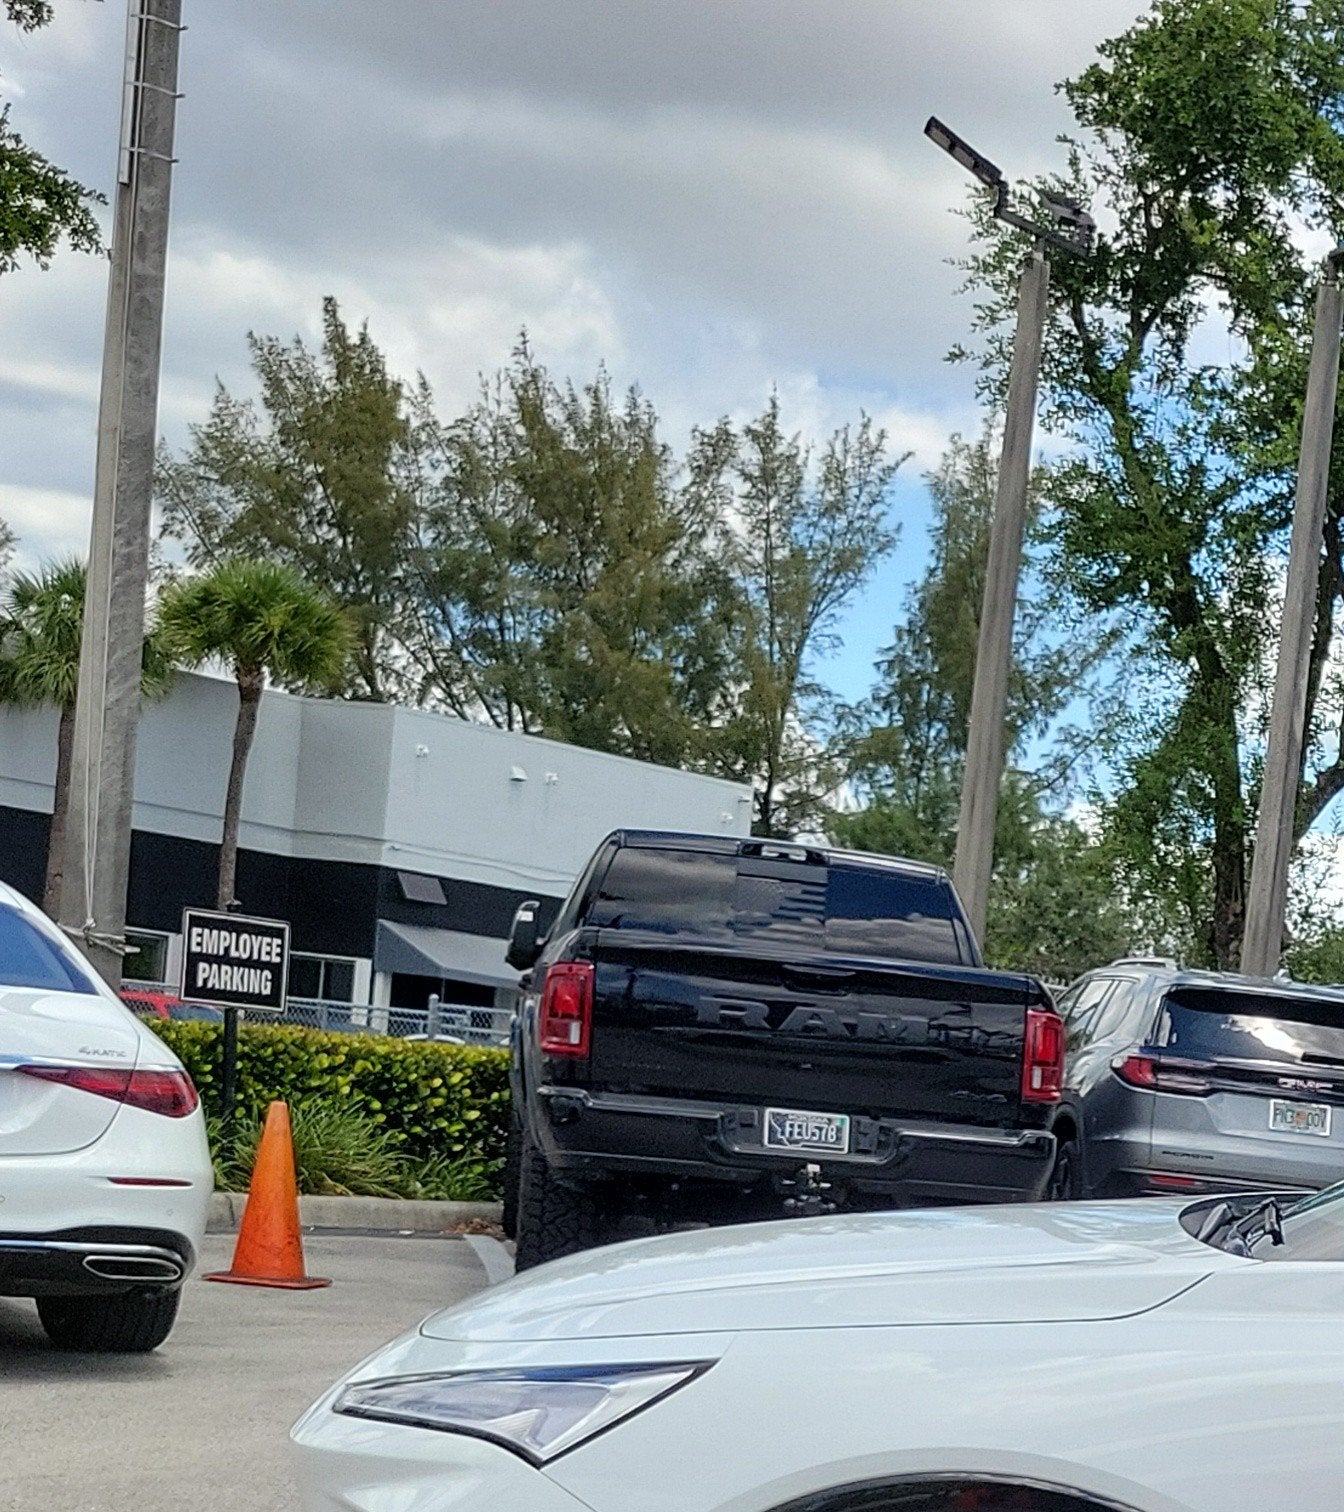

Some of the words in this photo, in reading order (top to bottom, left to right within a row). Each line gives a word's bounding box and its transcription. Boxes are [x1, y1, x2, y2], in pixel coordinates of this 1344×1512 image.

[189, 926, 283, 963] EMPLOYEE
[195, 960, 273, 996] PARKING
[698, 995, 929, 1042] RAM
